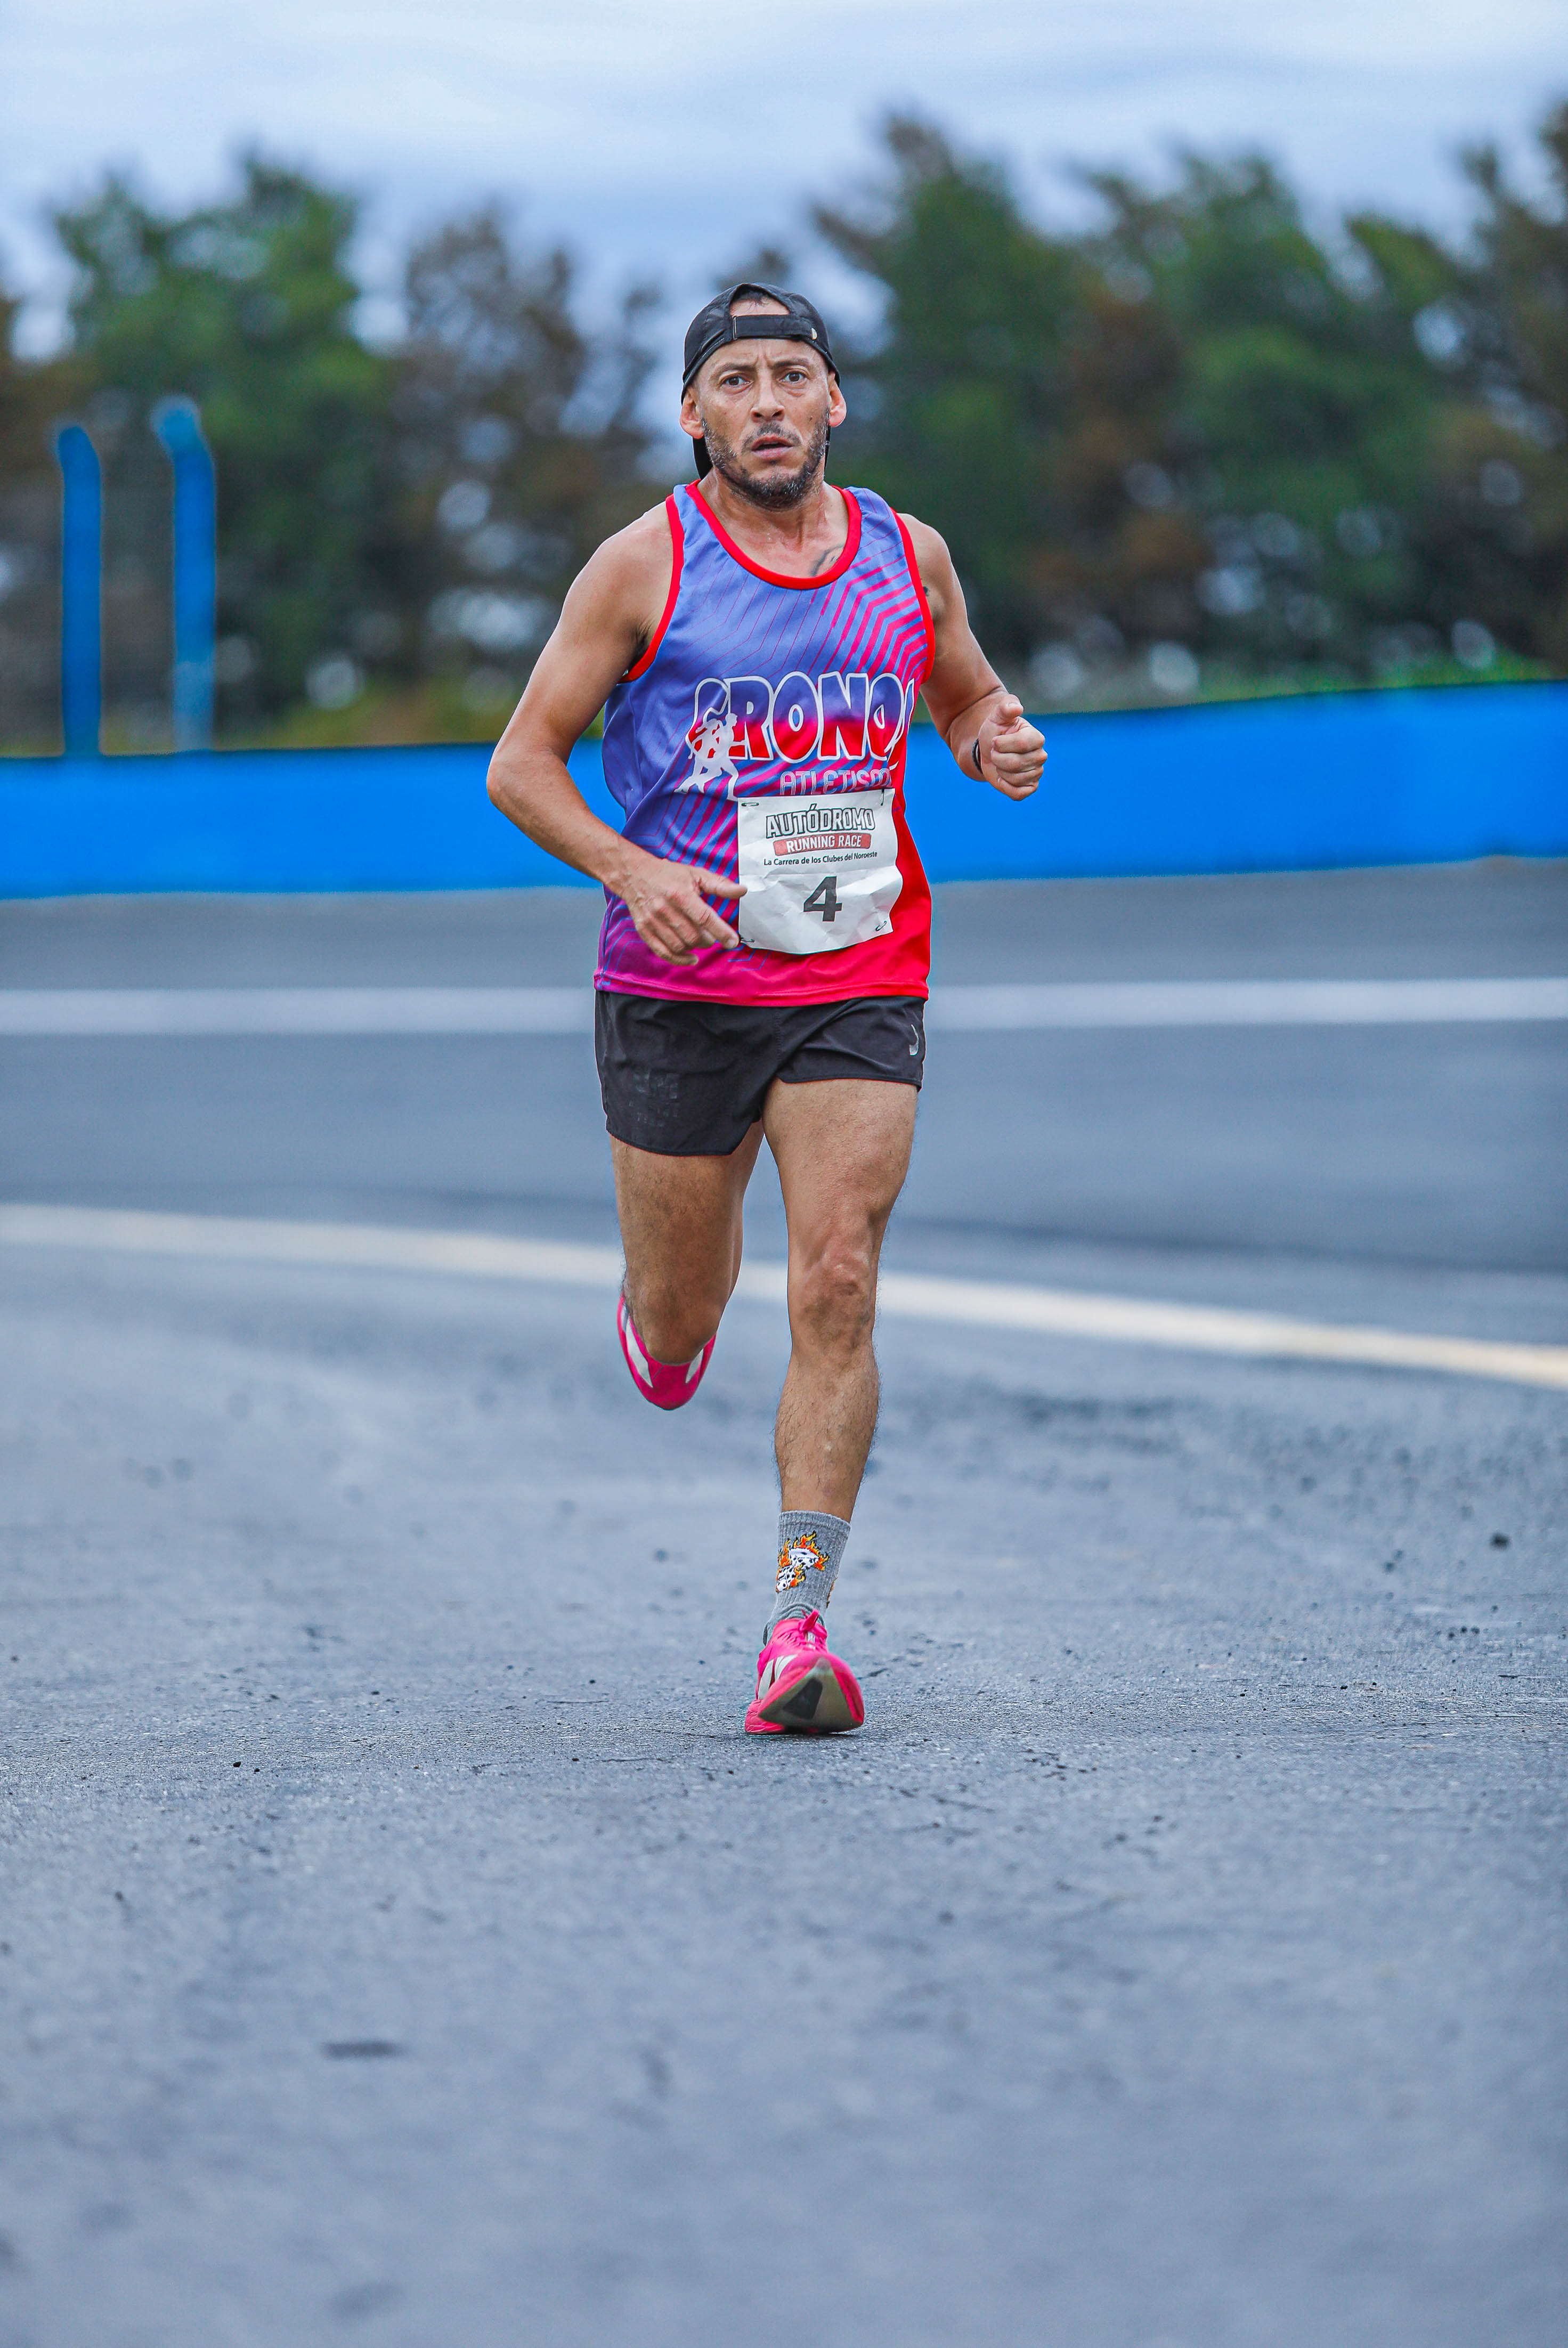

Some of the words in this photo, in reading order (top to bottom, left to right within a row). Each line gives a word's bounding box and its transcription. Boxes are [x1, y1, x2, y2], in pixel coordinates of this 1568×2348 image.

[780, 768, 892, 795] ATLETISM
[766, 803, 875, 839] AUTÓDROMO
[786, 835, 835, 854] RUNNING
[838, 834, 863, 848] RACE
[822, 853, 843, 863] Clubes
[844, 852, 853, 860] del
[854, 851, 878, 859] Noroeste
[803, 875, 843, 922] 4
